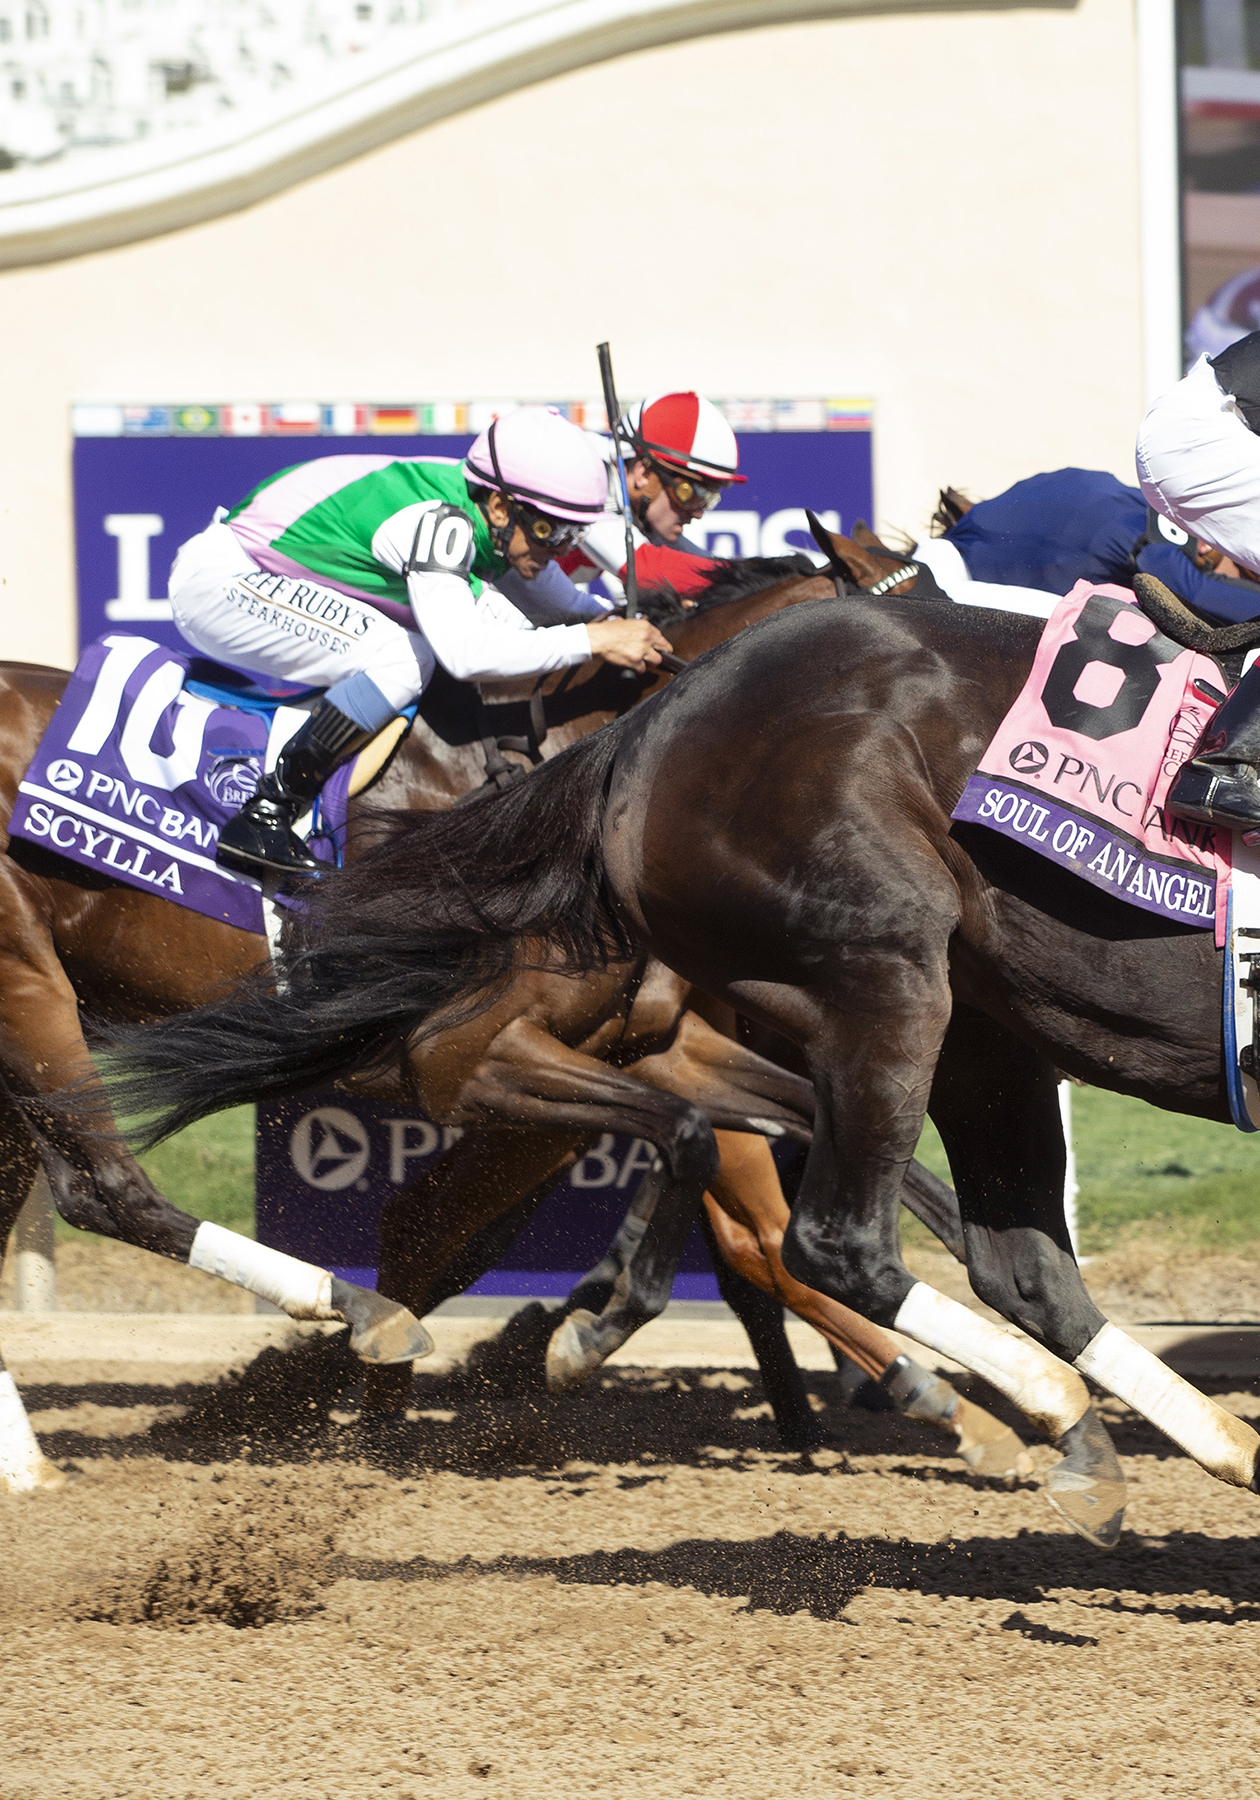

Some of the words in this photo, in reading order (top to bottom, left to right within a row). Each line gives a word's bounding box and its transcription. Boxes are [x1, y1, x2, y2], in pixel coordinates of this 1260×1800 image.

[415, 511, 473, 568] 10
[226, 588, 351, 655] STEAKHOUSES
[243, 573, 294, 600] EFF
[288, 583, 376, 637] RUBY'S
[1040, 594, 1188, 741] 8
[66, 635, 220, 792] 10
[86, 769, 160, 825] PNC
[159, 805, 220, 848] BAN
[1053, 753, 1143, 817] PNC
[24, 803, 185, 895] SCYLLA
[977, 788, 1050, 843] SOUL
[1051, 820, 1095, 860] OF
[1088, 841, 1136, 885] AN
[1126, 869, 1217, 921] ANGEL
